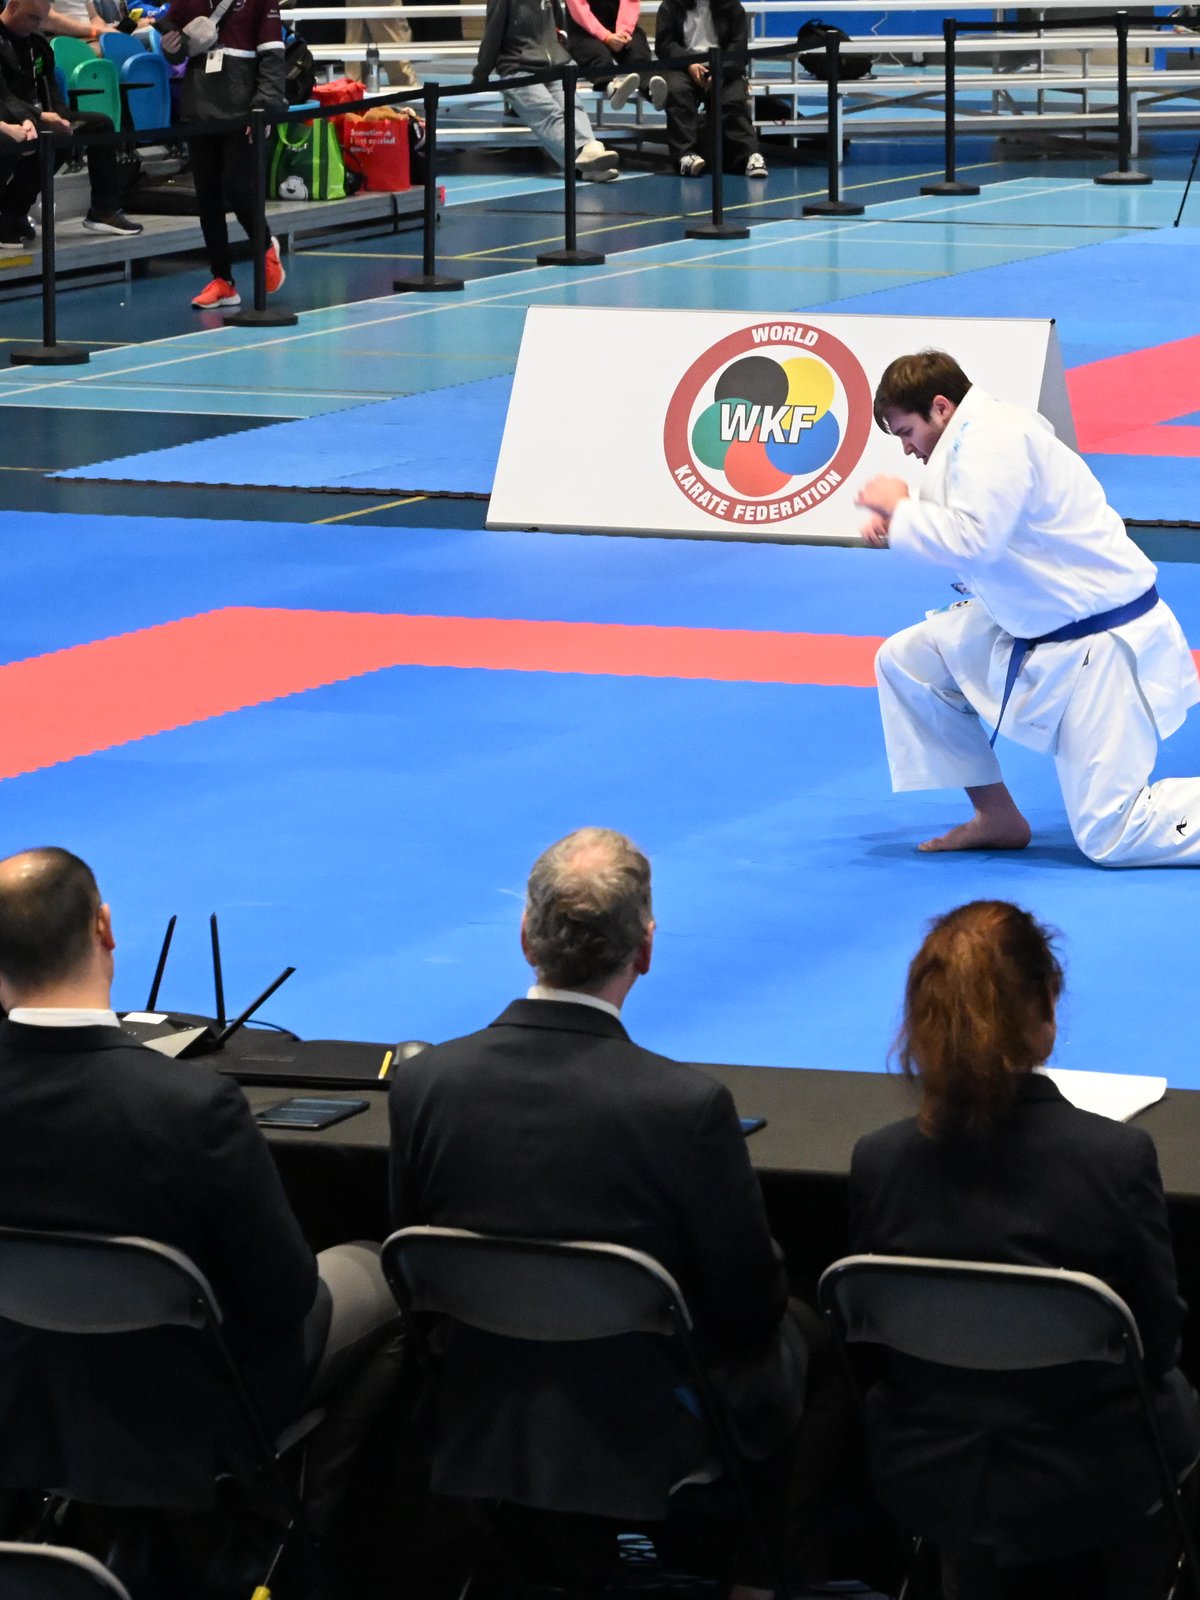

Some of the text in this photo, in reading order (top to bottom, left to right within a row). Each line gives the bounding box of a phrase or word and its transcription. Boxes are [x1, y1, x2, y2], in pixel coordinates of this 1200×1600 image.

[752, 325, 819, 347] WORLD
[719, 403, 817, 444] WKF
[674, 464, 842, 521] KARATE FEDERATION
